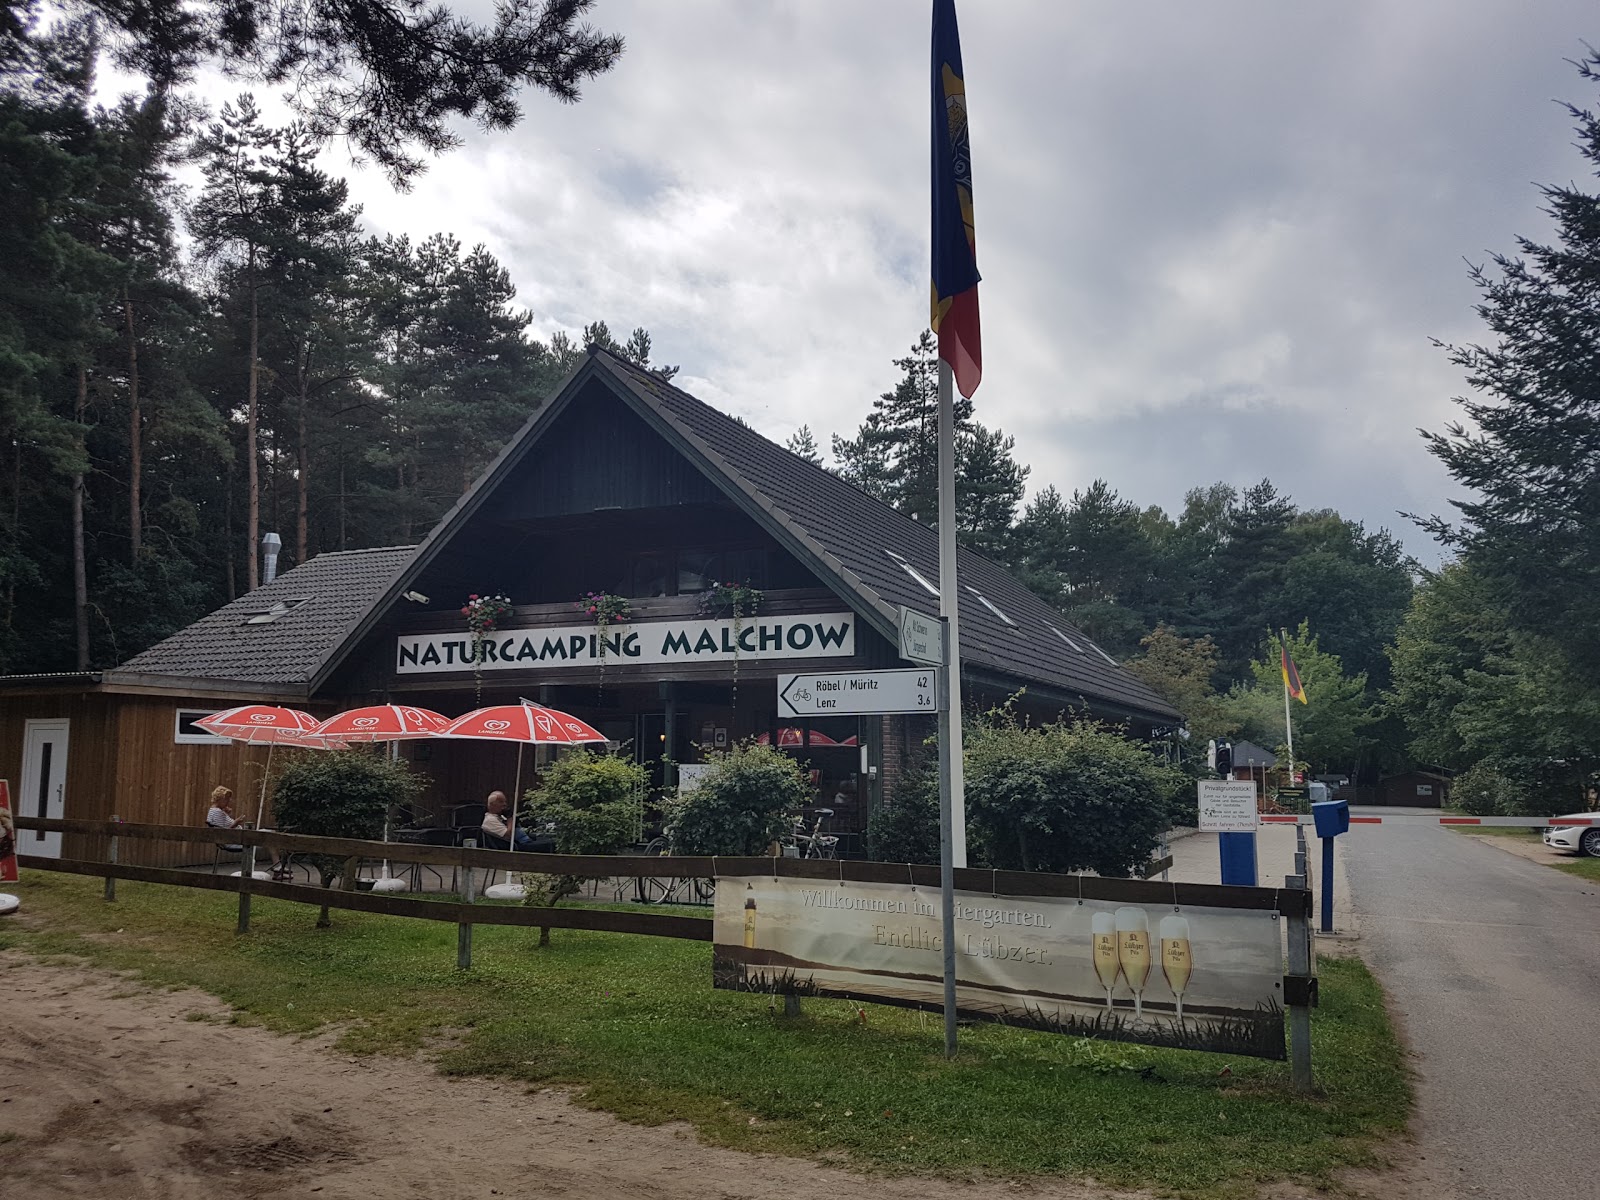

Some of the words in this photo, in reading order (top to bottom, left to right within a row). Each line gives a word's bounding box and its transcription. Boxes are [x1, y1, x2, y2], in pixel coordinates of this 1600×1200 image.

[399, 632, 642, 667] NATURCAMPING
[660, 622, 850, 656] MALCHOW
[816, 680, 840, 692] Röbel
[843, 679, 847, 691] /
[850, 679, 878, 691] Müritz
[917, 677, 928, 688] 42
[816, 697, 836, 708] Lenz
[800, 889, 907, 914] Willkommen
[913, 898, 936, 918] im
[952, 901, 1052, 929] iergarten.
[872, 924, 957, 953] Endlic
[963, 933, 1053, 966] Lübzer.
